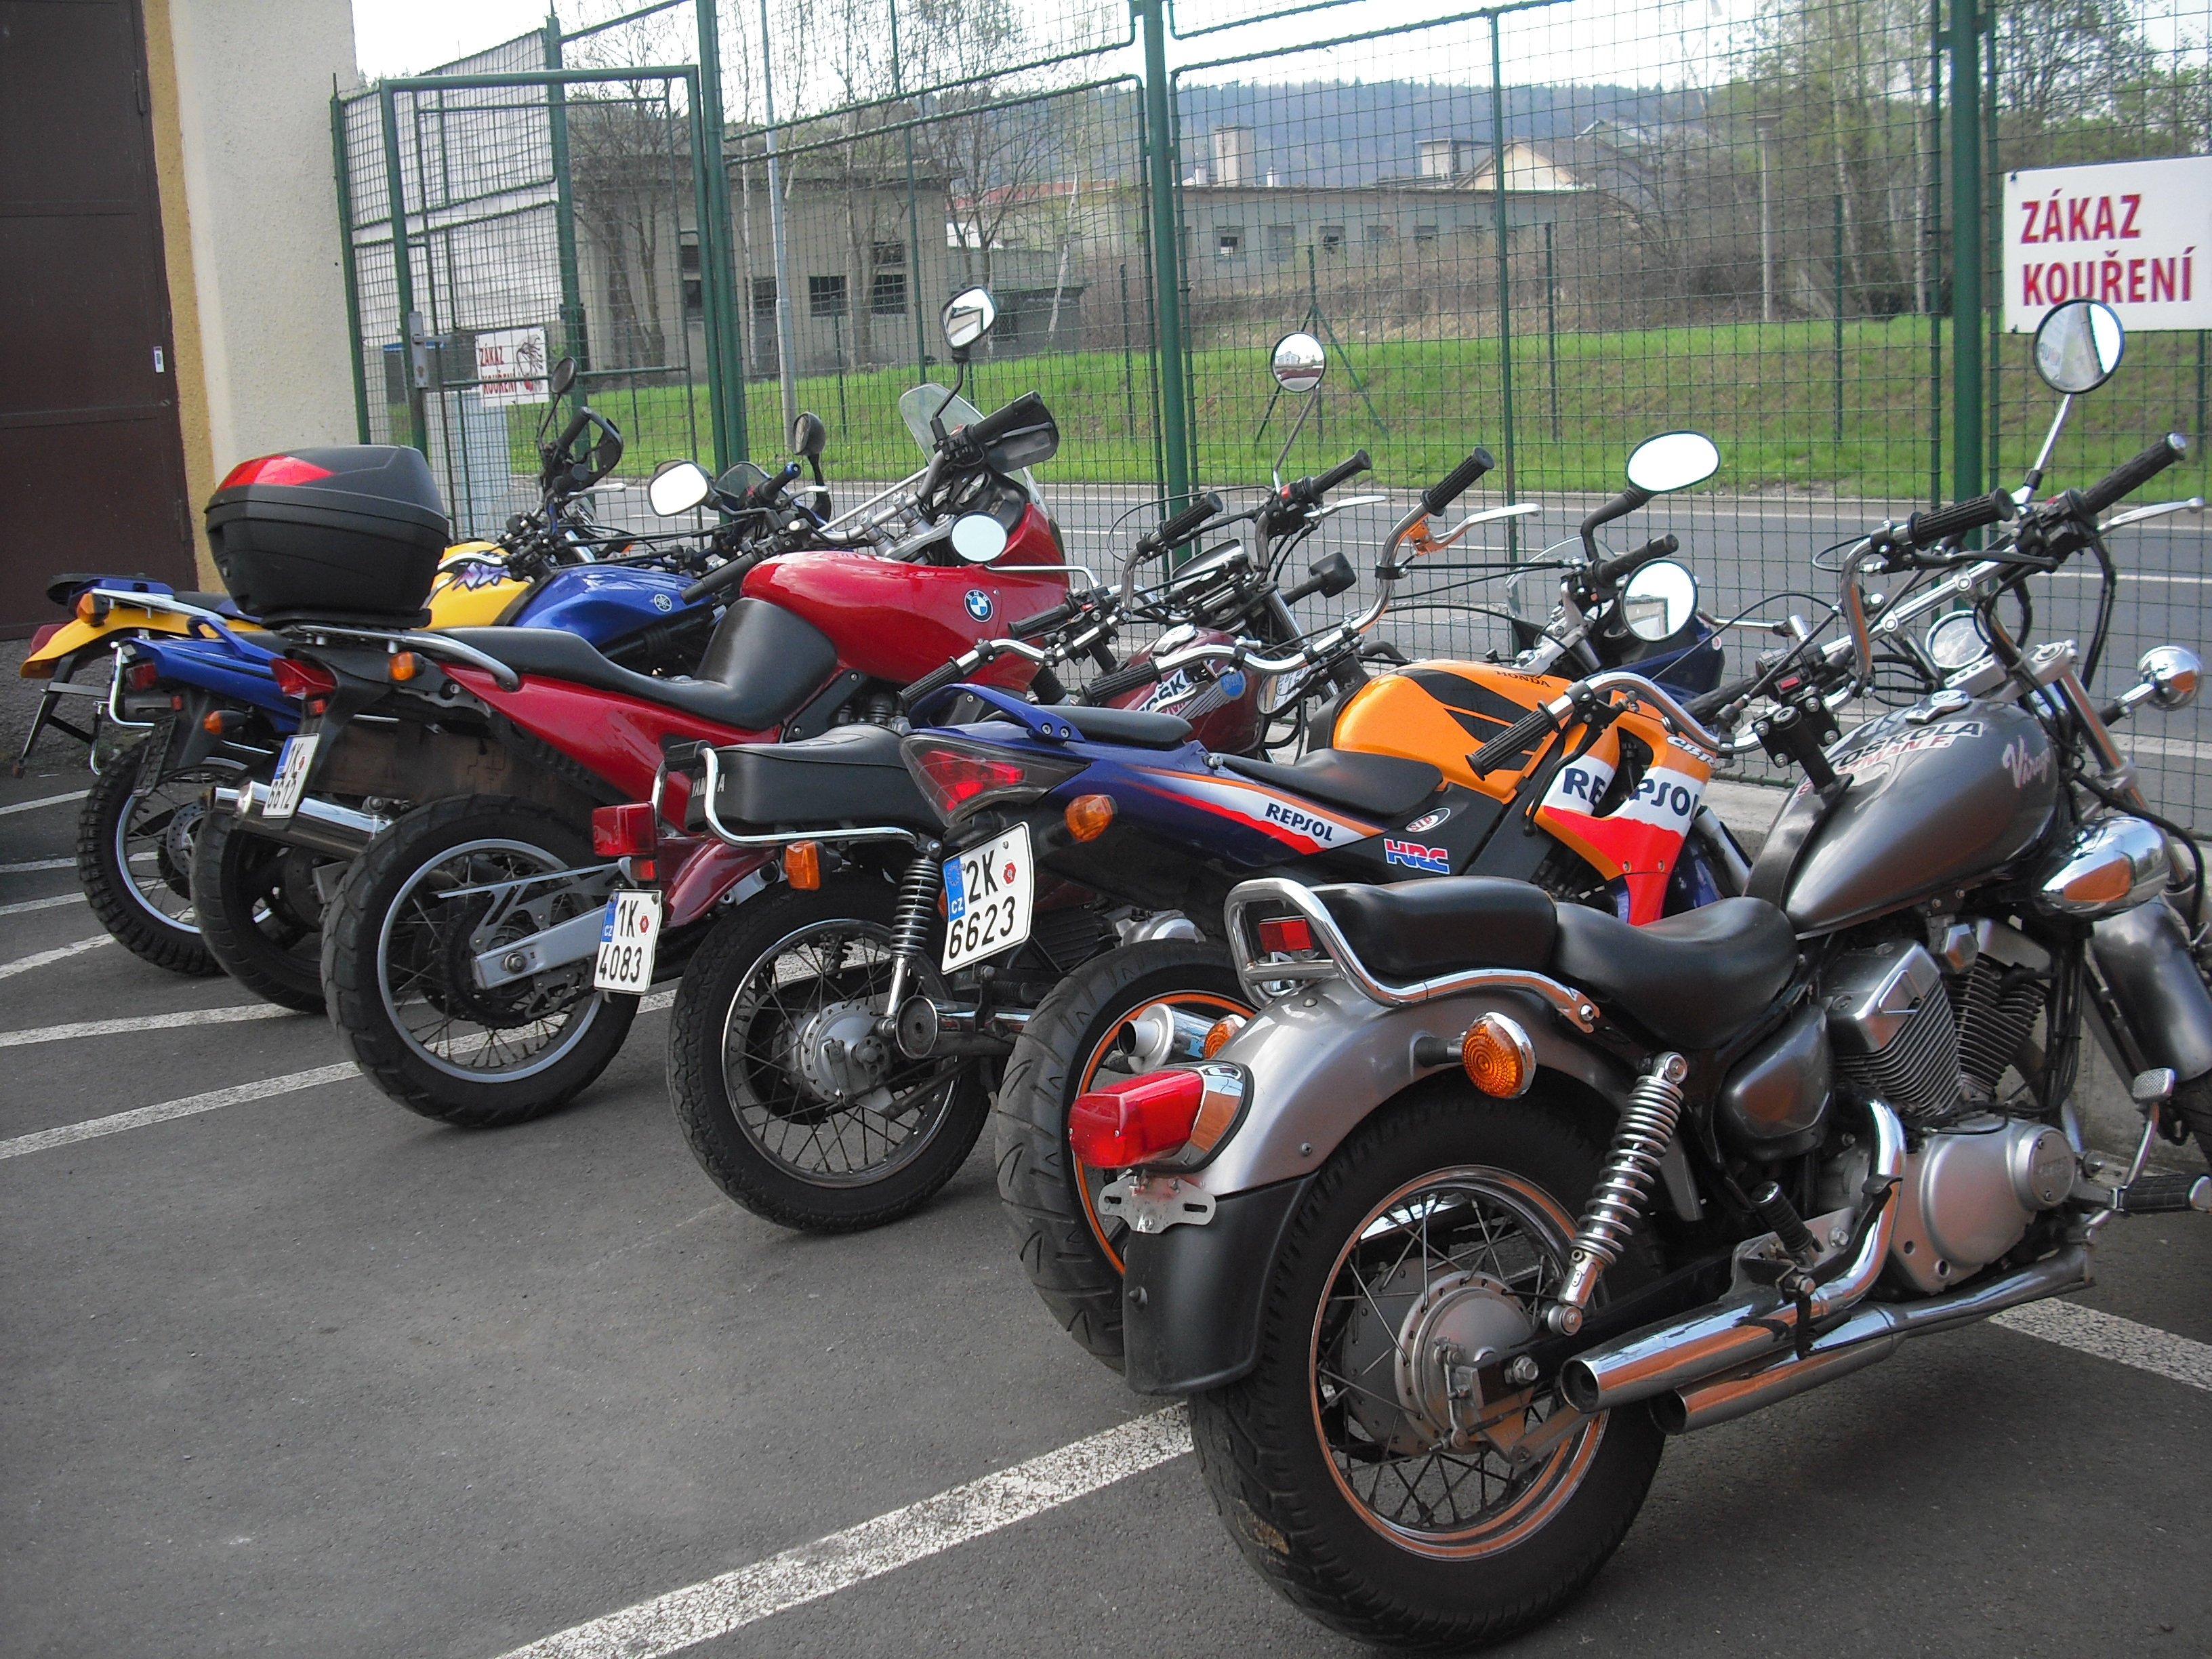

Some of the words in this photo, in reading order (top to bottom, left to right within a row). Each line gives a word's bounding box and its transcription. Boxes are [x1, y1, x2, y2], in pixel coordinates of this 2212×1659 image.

[2020, 188, 2142, 245] ZÁKAZ
[2022, 245, 2197, 306] KOUŘENÍ
[479, 342, 504, 367] ZÁKAZ
[1496, 670, 1551, 689] HONDA
[1666, 735, 1717, 769] CBR
[267, 780, 297, 809] 6612
[1265, 802, 1333, 842] REPSOL
[1384, 838, 1450, 875] HRC
[966, 849, 998, 905] 2K
[618, 899, 639, 939] 1K
[951, 897, 964, 915] CZ
[604, 924, 613, 937] CZ
[949, 895, 1017, 960] 6623
[598, 943, 642, 983] 4083
